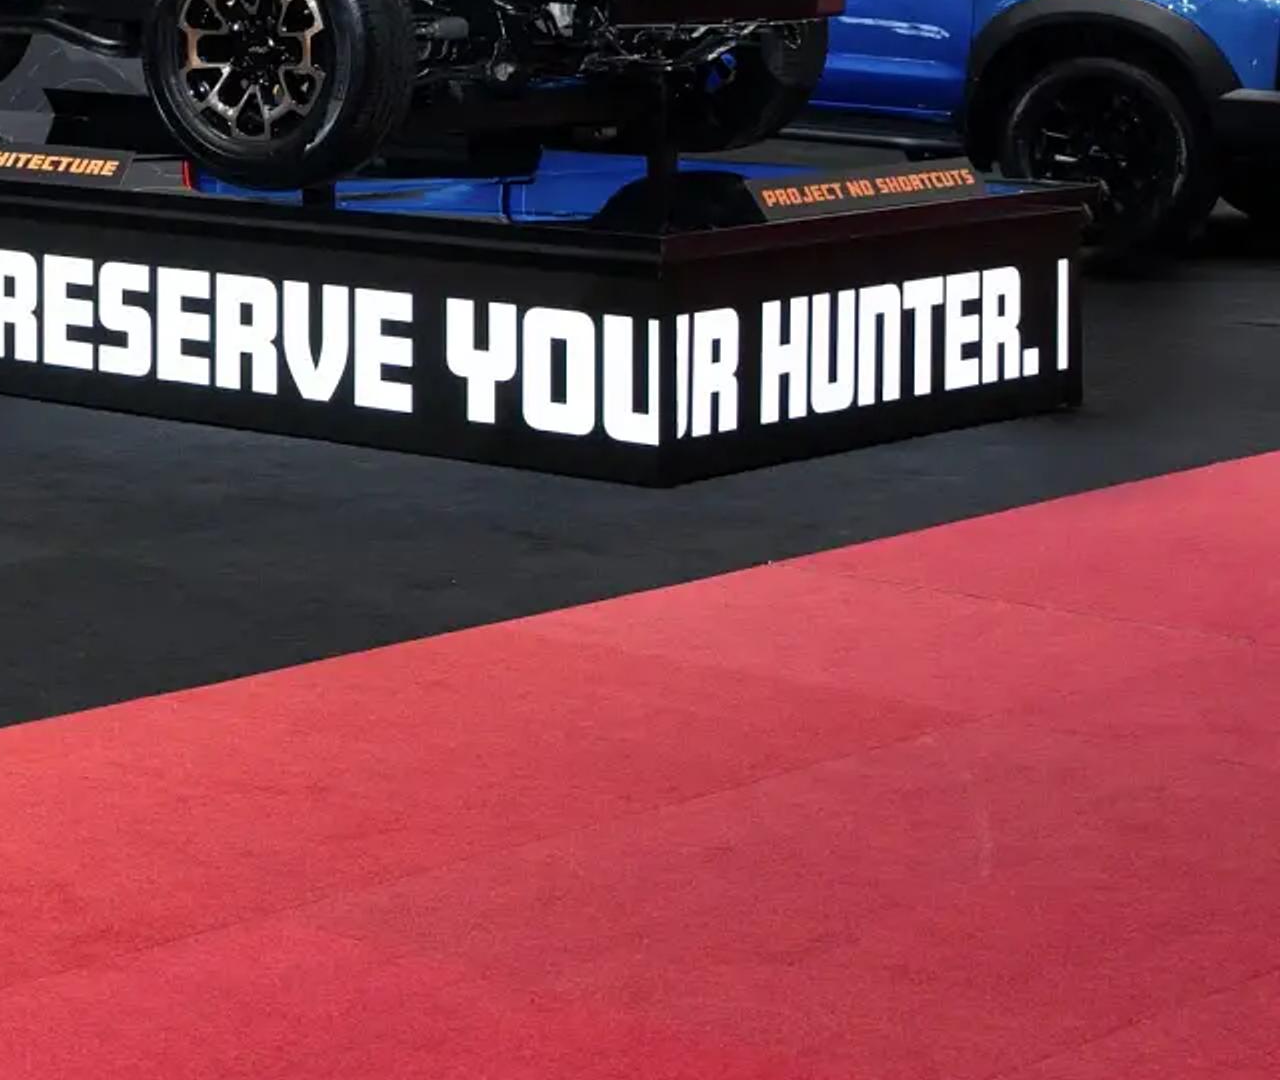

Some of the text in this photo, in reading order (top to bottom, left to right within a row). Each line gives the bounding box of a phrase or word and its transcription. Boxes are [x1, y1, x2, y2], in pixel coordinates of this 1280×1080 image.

[762, 168, 975, 207] PROJECT NO SHORTCUTS
[760, 266, 1039, 425] HUNTER.
